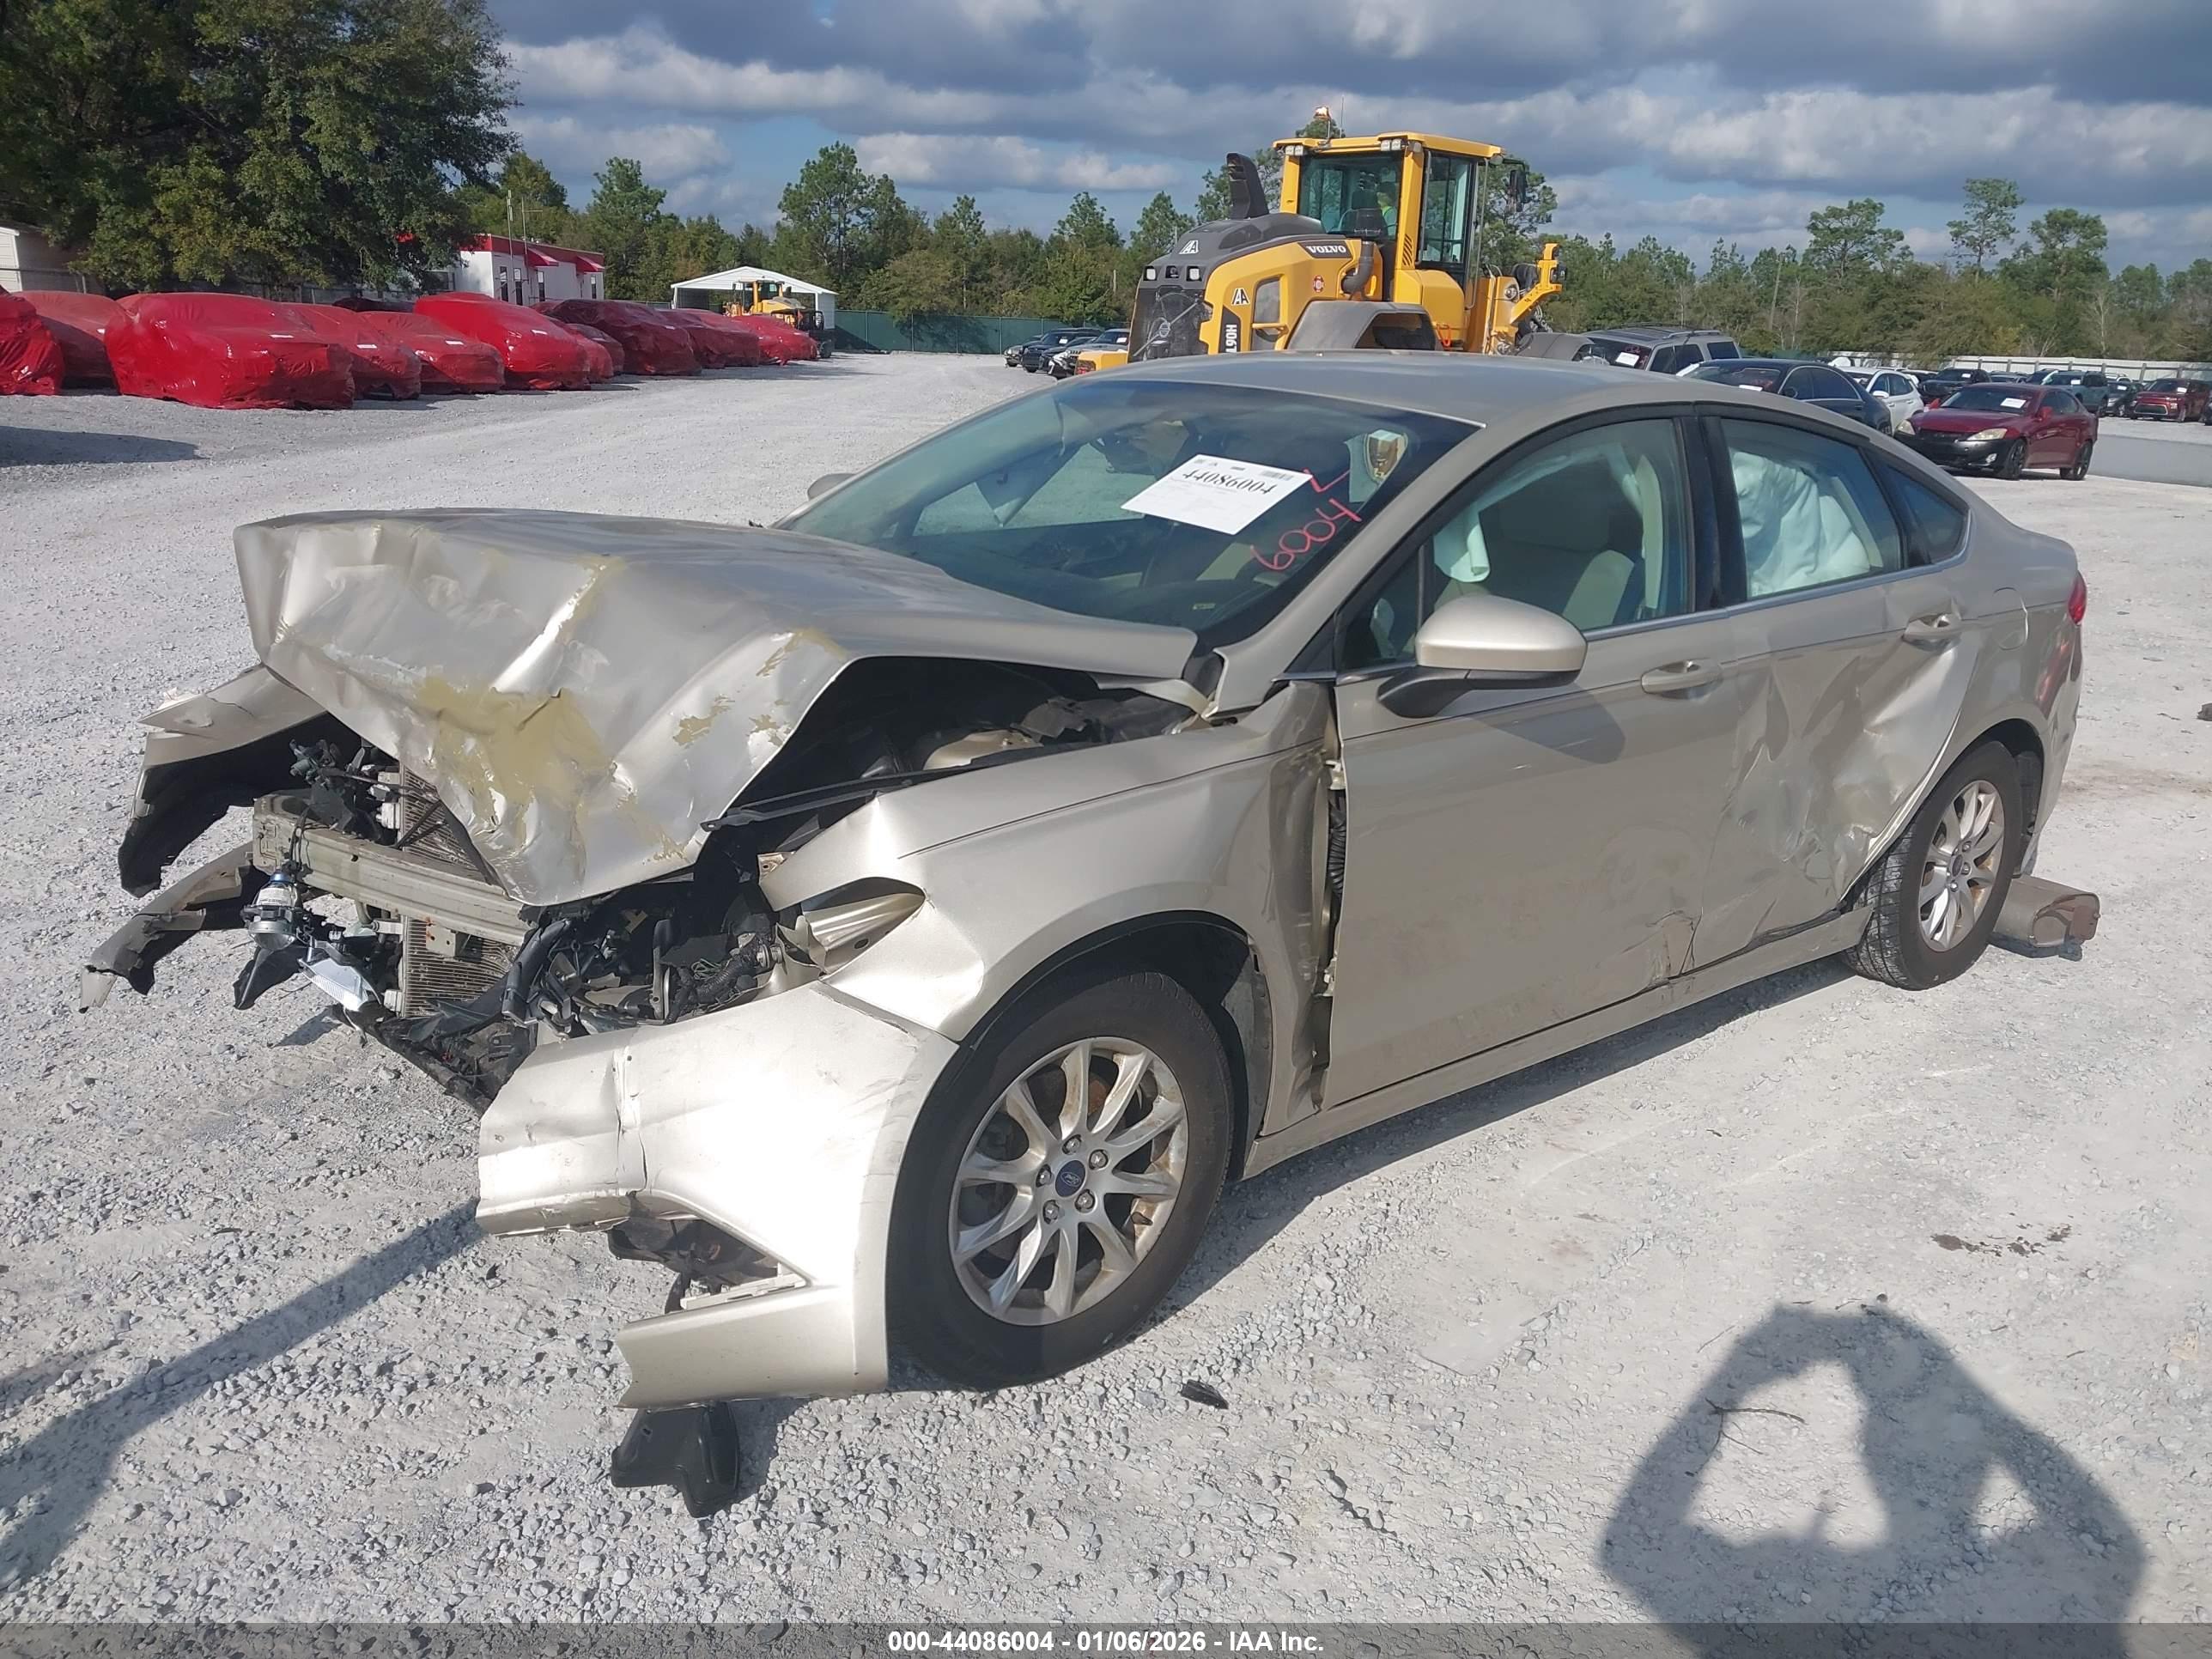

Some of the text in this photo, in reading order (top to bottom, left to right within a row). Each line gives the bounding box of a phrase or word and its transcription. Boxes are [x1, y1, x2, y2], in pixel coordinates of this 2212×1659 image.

[1305, 245, 1346, 253] VOLVO
[1182, 469, 1278, 495] 44086004
[1249, 497, 1363, 571] 6004
